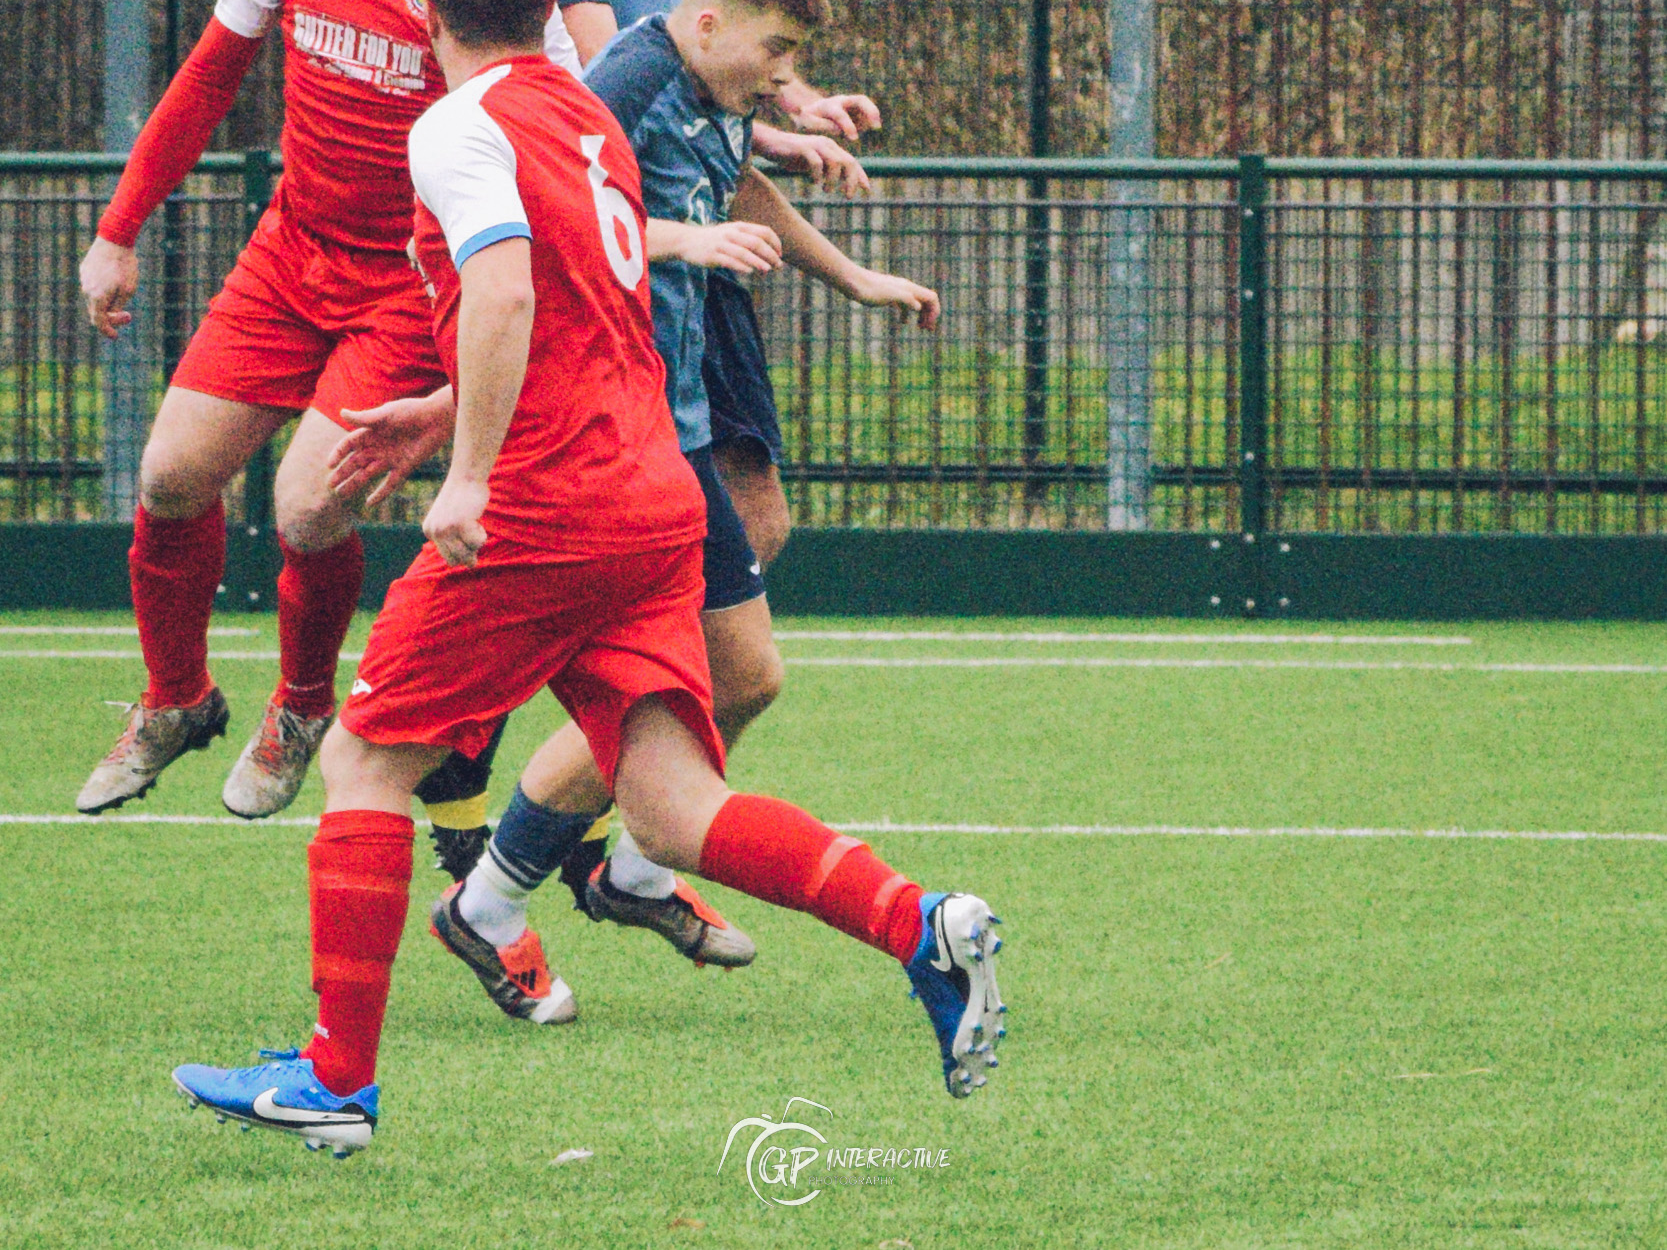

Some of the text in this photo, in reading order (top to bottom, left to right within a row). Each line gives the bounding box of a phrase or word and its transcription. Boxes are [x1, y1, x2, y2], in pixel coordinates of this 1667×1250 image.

[358, 32, 389, 68] FOR
[392, 43, 423, 76] YOU
[580, 135, 643, 291] 6
